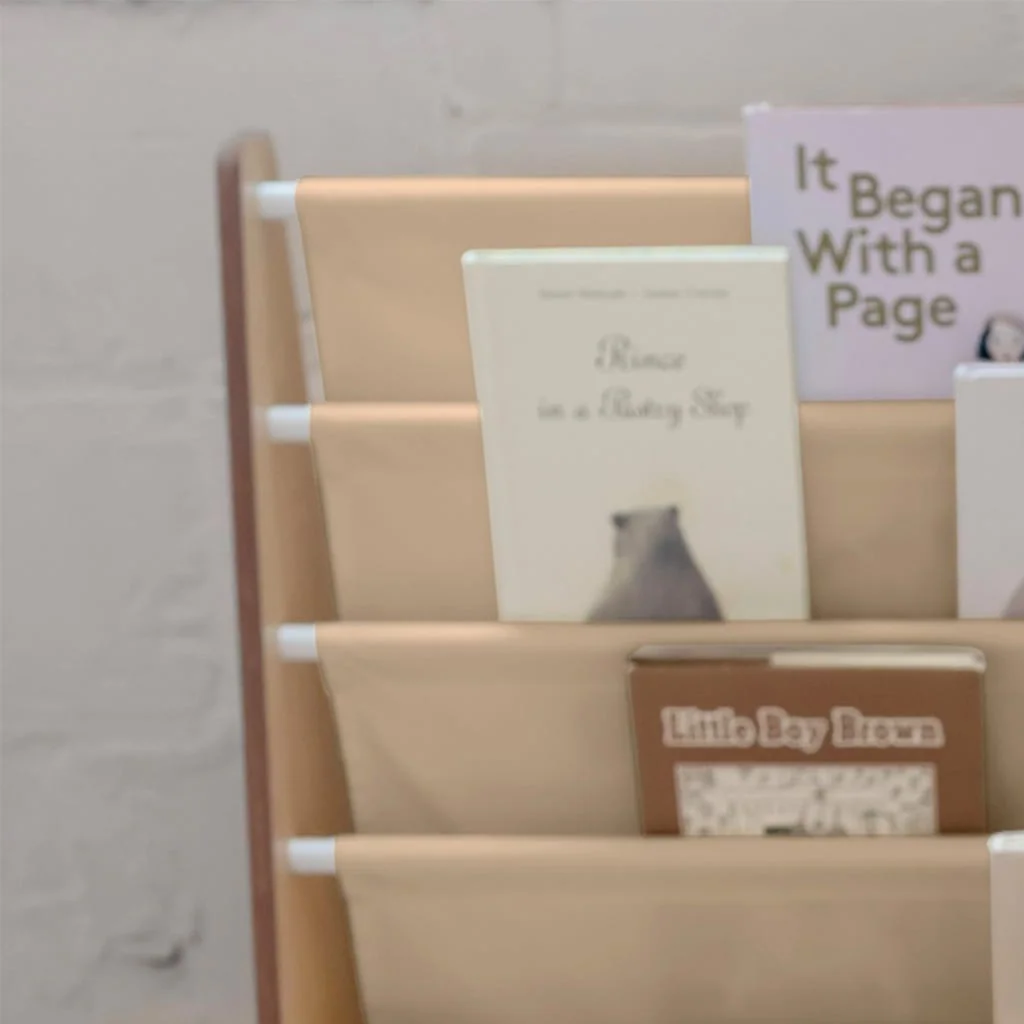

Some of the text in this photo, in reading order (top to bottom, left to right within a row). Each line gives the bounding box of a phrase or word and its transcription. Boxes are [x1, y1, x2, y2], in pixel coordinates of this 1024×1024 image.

[796, 144, 838, 191] It
[850, 173, 1022, 235] Began
[797, 227, 982, 275] With a
[827, 283, 958, 343] Page
[661, 705, 947, 755] Little Boy Brown
